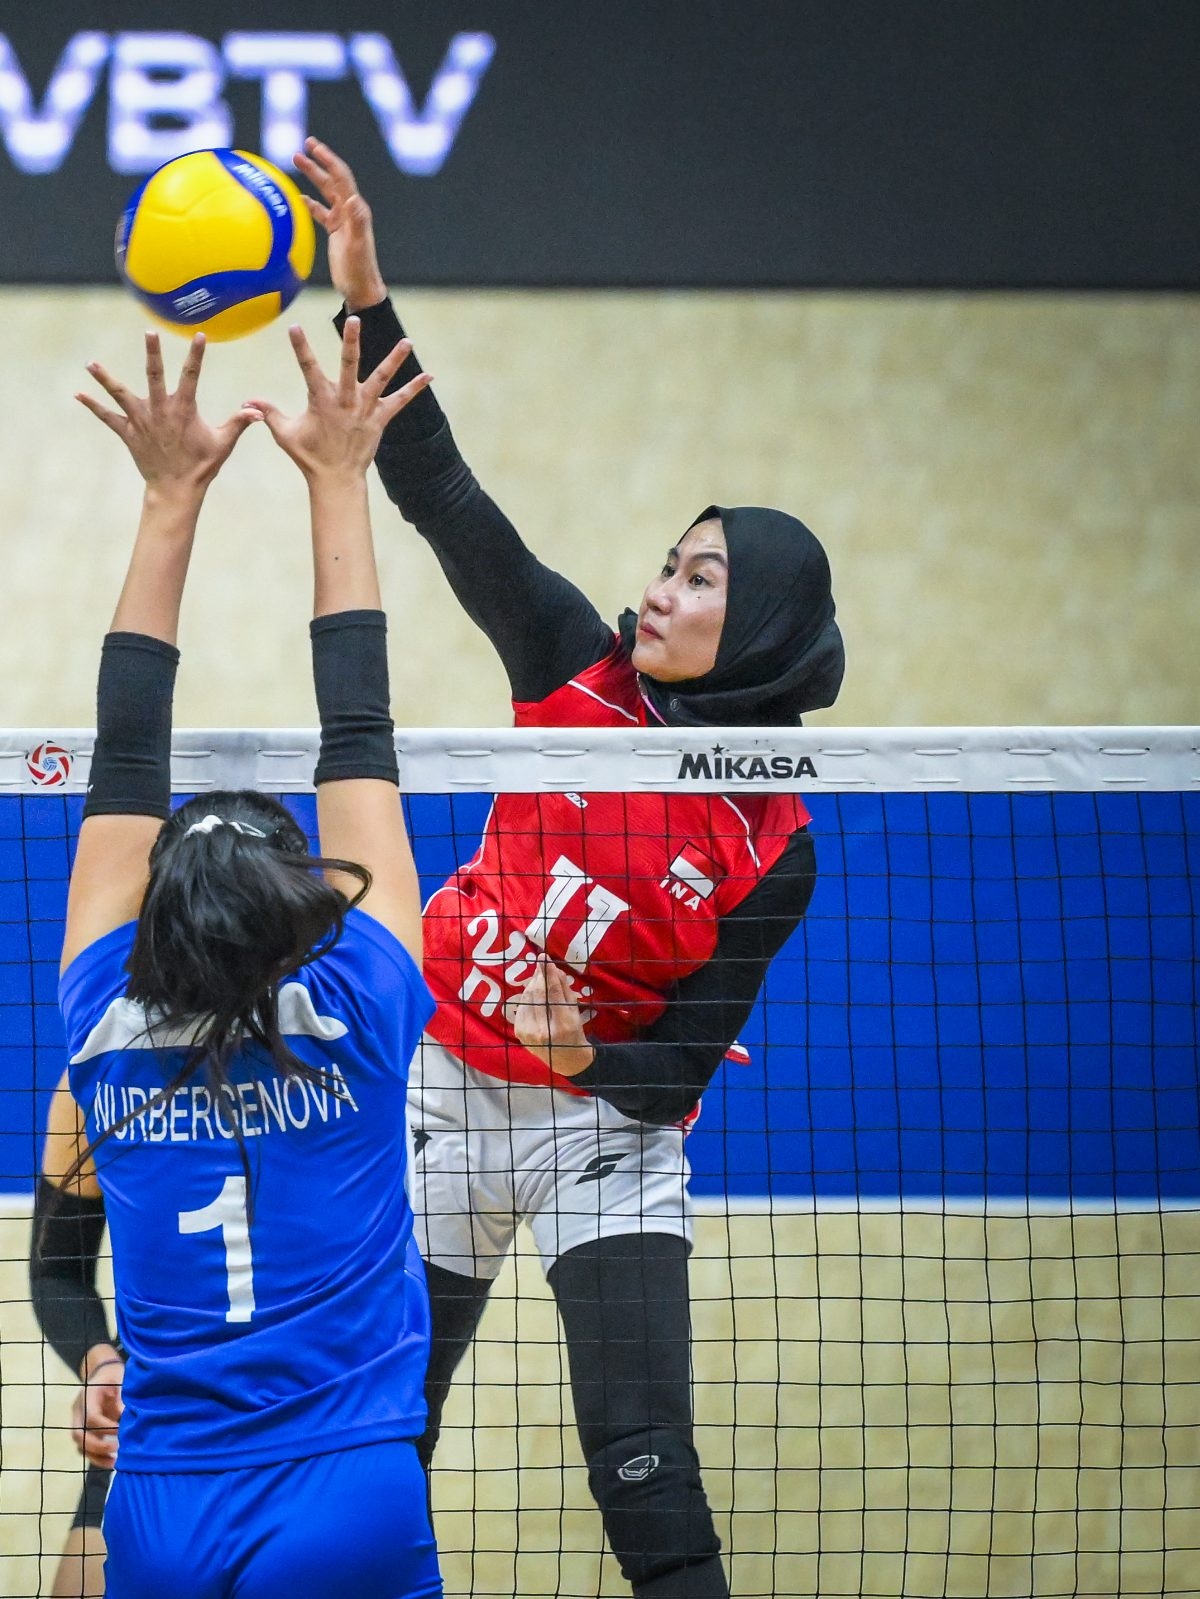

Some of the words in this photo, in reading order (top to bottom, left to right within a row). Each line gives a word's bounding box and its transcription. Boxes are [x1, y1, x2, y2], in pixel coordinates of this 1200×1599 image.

[659, 874, 701, 911] INA
[93, 1062, 360, 1143] NURBERGENOVA
[178, 1175, 256, 1323] 1
